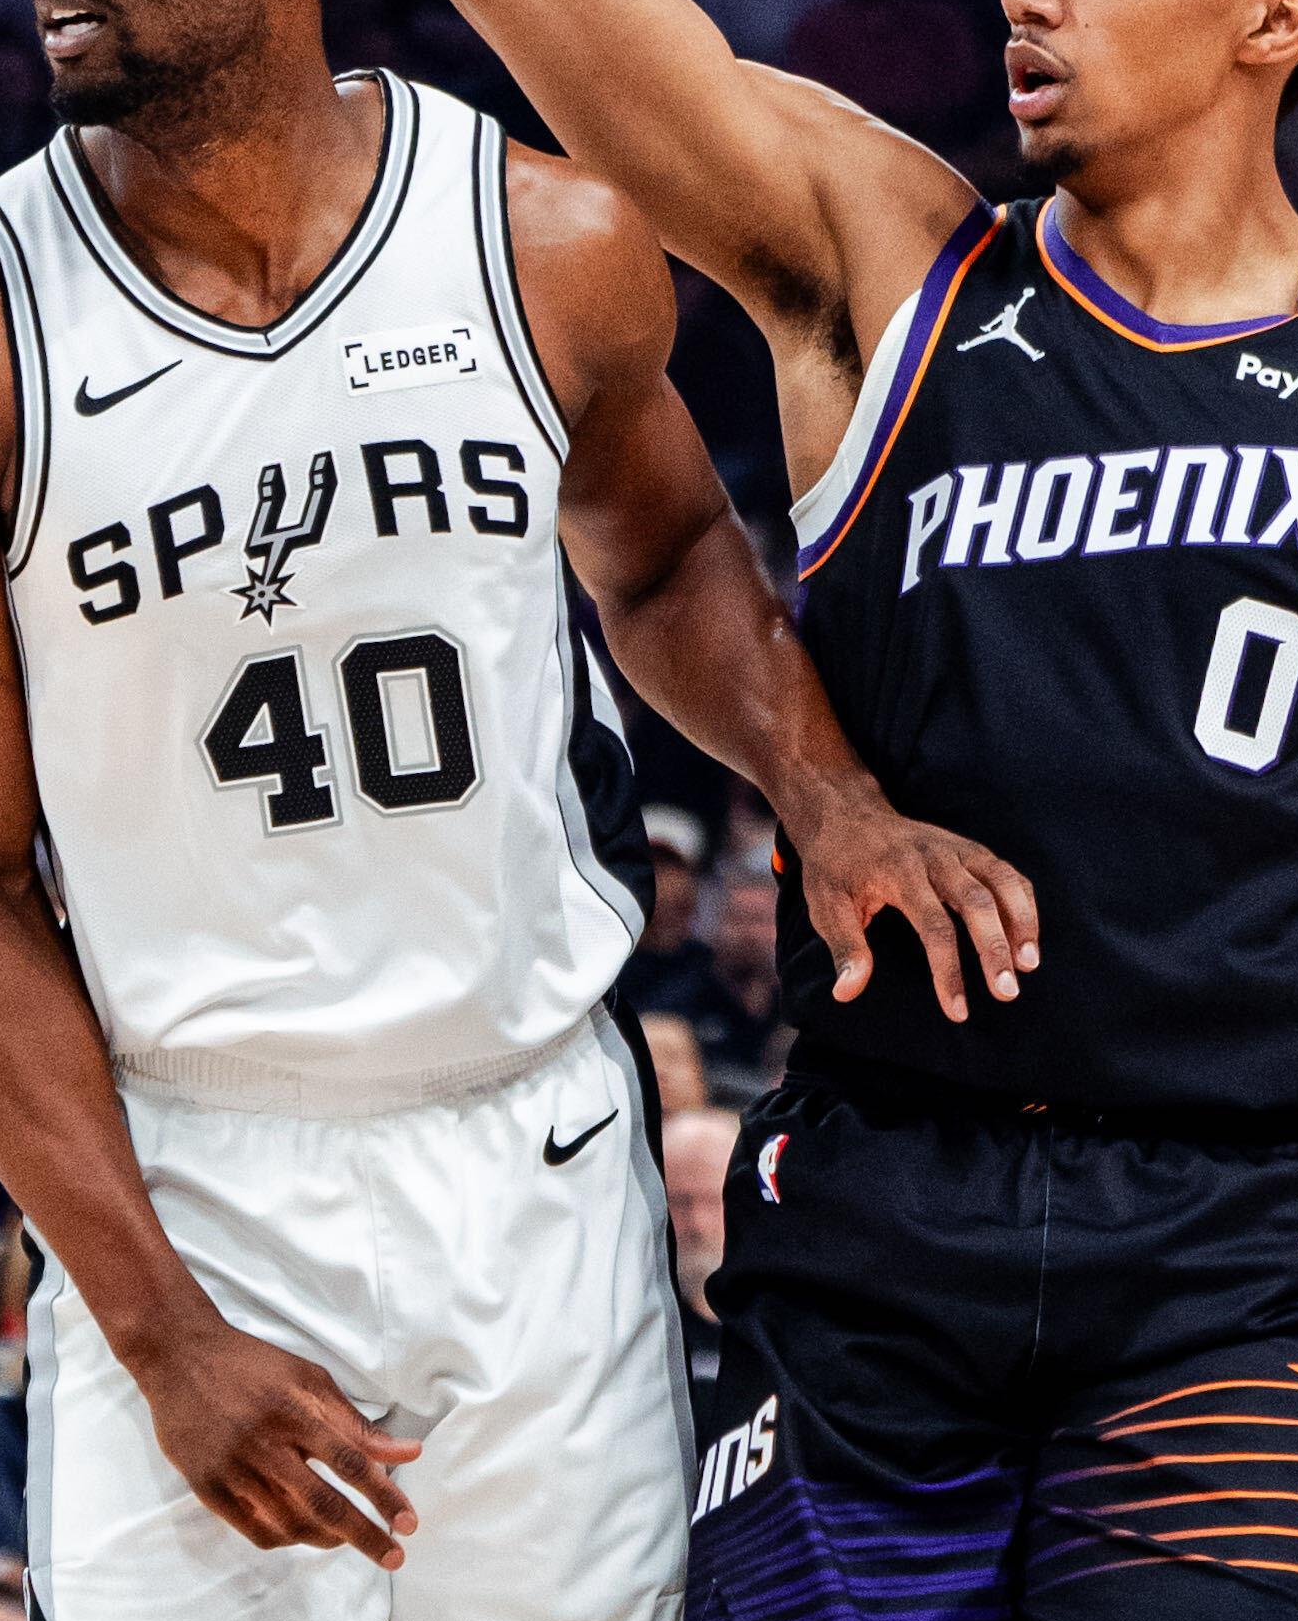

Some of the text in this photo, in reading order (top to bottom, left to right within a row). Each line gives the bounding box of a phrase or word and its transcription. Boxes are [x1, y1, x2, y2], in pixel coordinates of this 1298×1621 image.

[364, 343, 458, 374] LEDGER
[66, 439, 529, 627] SPURS
[196, 626, 484, 837] 40
